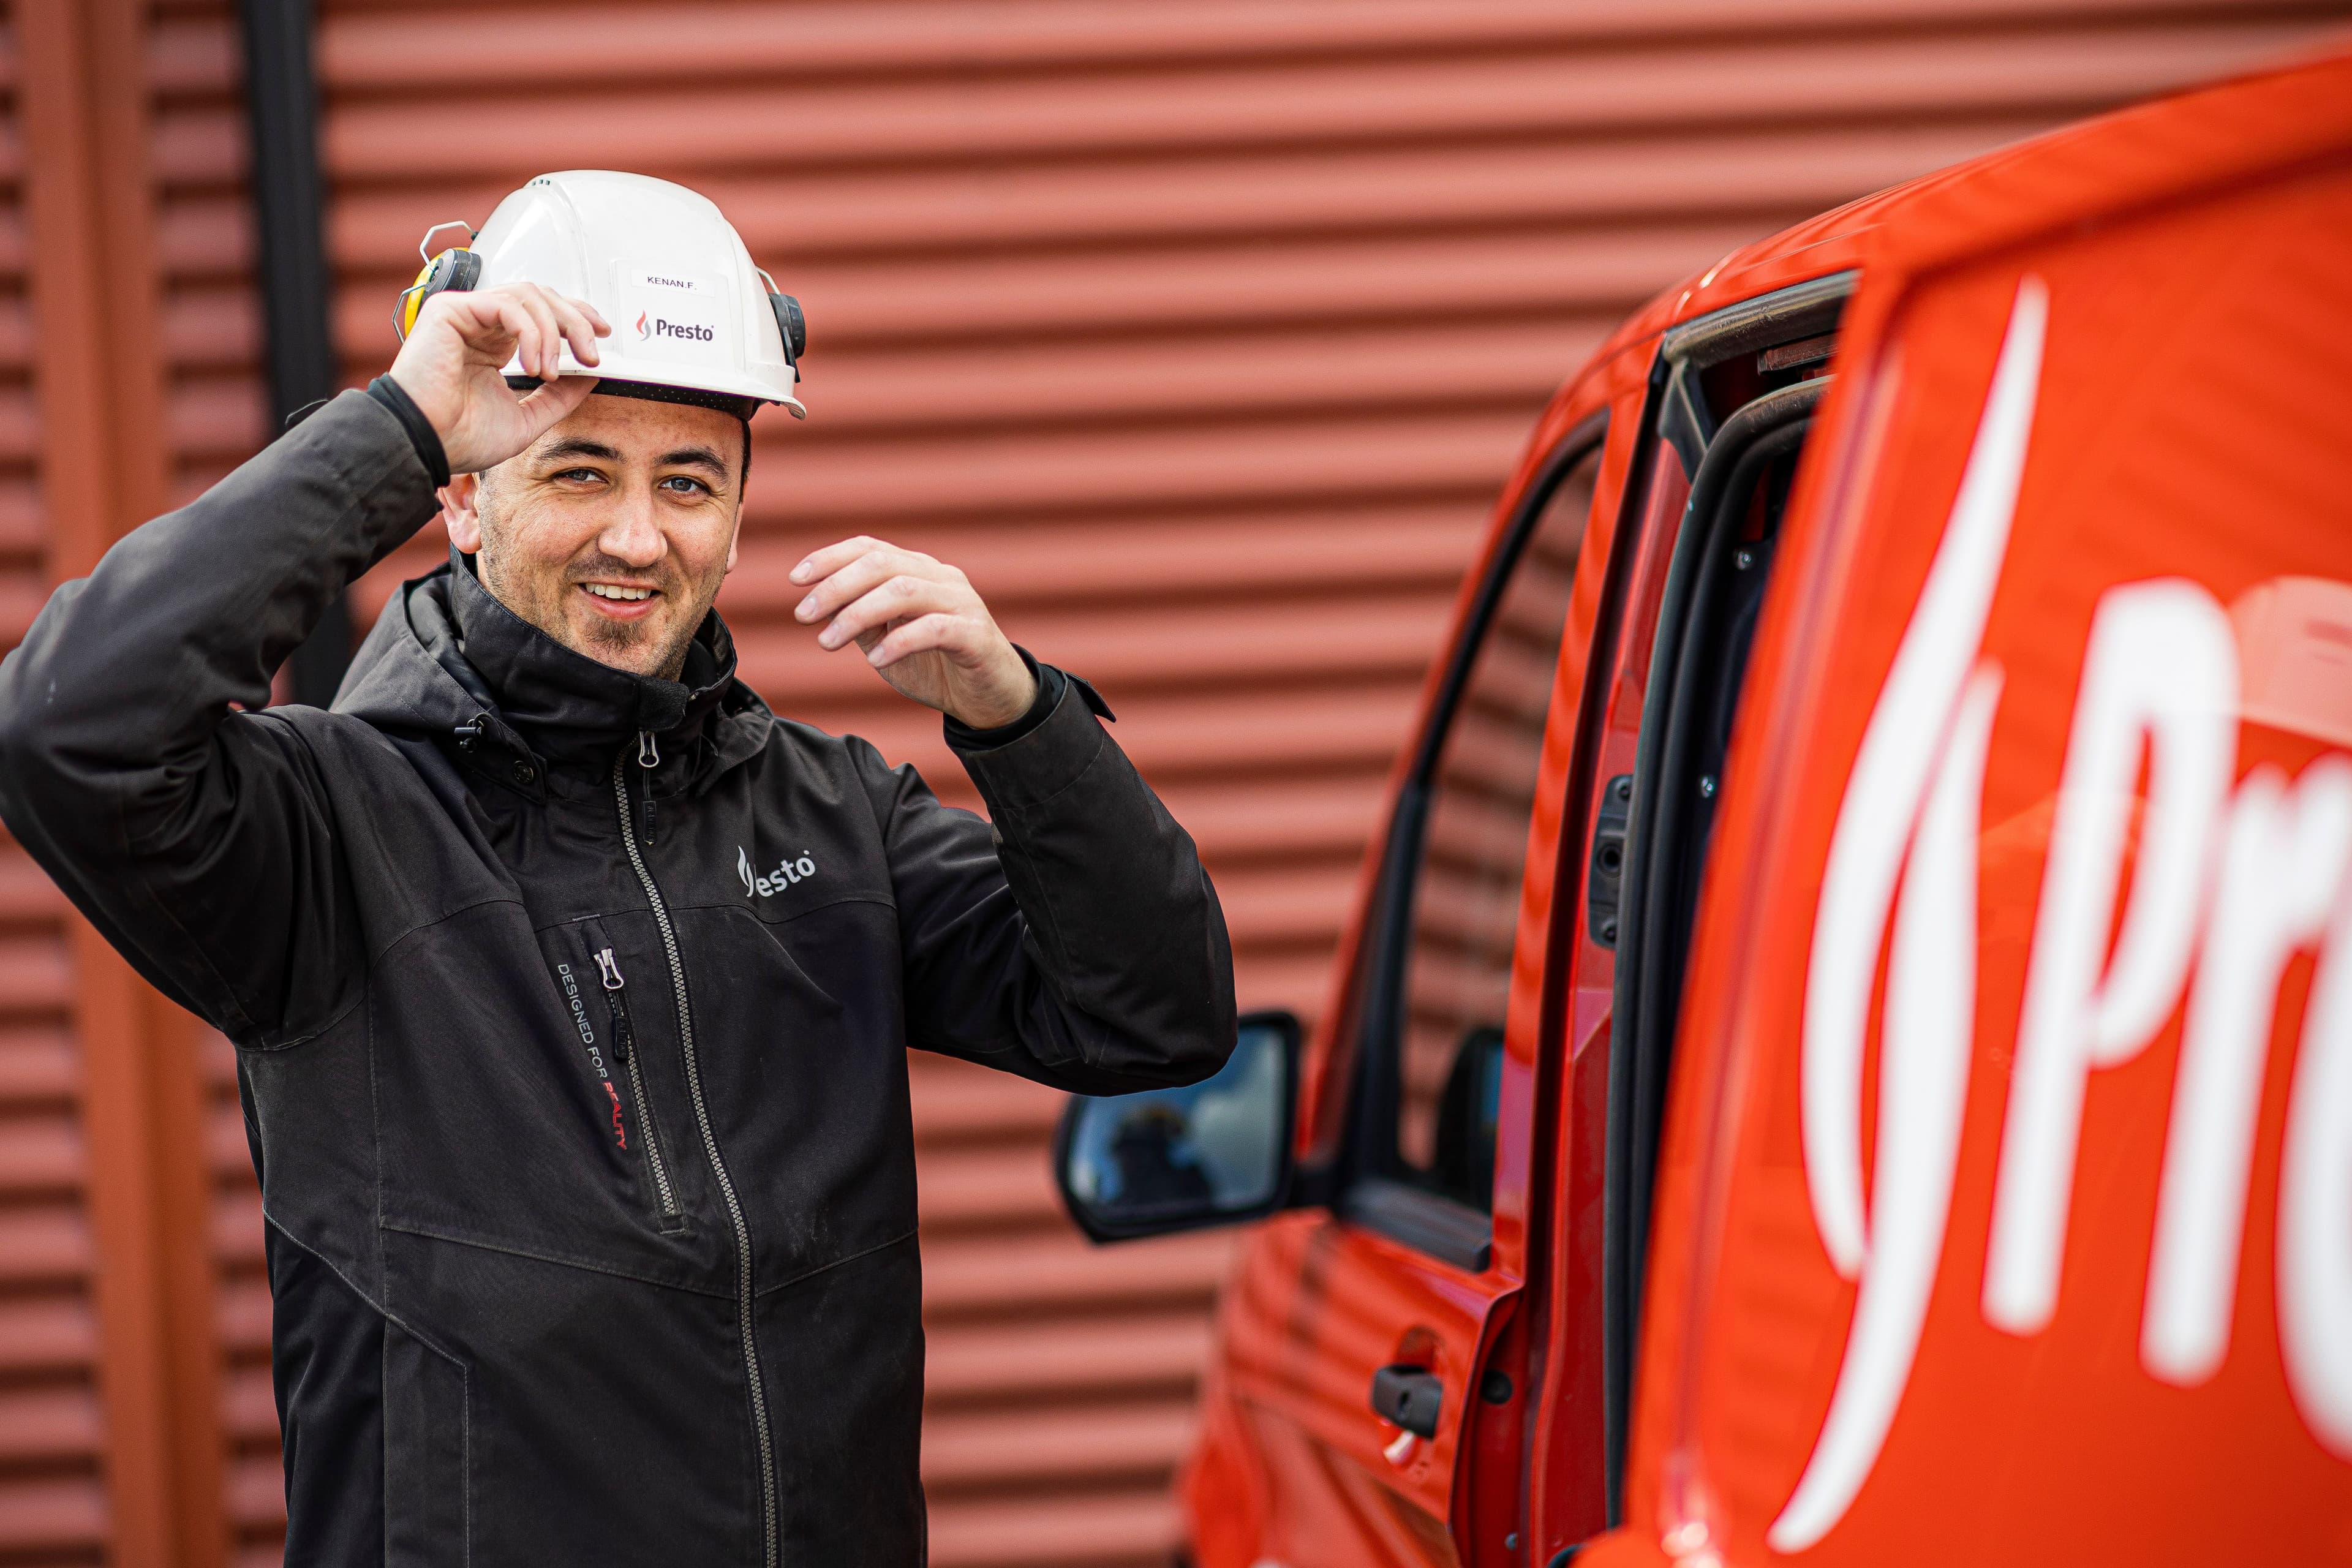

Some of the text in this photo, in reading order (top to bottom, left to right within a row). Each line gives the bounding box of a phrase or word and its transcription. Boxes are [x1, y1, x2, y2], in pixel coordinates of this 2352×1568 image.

[657, 318, 713, 341] Presto
[754, 858, 816, 897] esto
[558, 964, 594, 1044] DESIGNED
[587, 1047, 608, 1079] FOR
